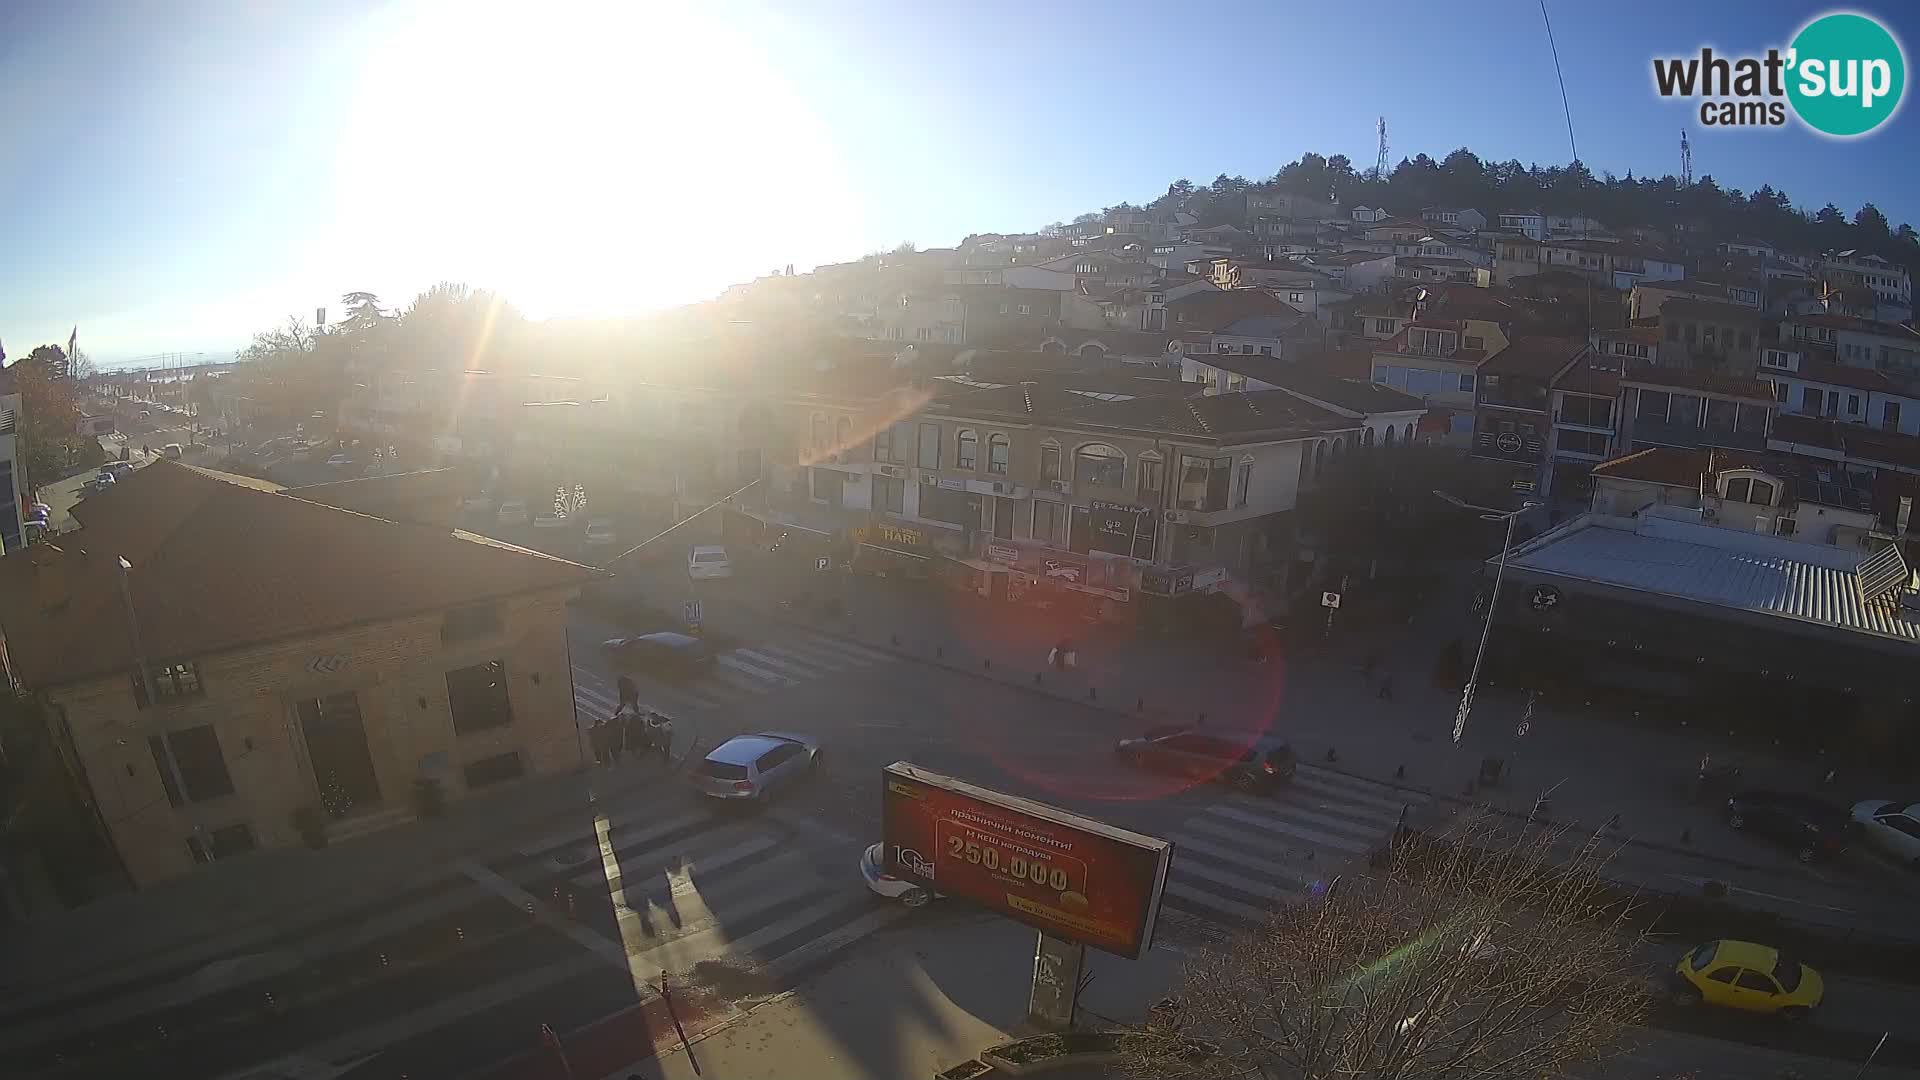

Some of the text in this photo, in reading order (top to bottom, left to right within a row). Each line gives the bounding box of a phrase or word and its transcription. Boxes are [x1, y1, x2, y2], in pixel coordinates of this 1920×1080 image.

[883, 530, 917, 545] HARI
[950, 808, 1012, 833] празнични
[1014, 828, 1073, 851] моменти!
[948, 835, 1068, 891] 250.000
[1000, 841, 1052, 861] наградува
